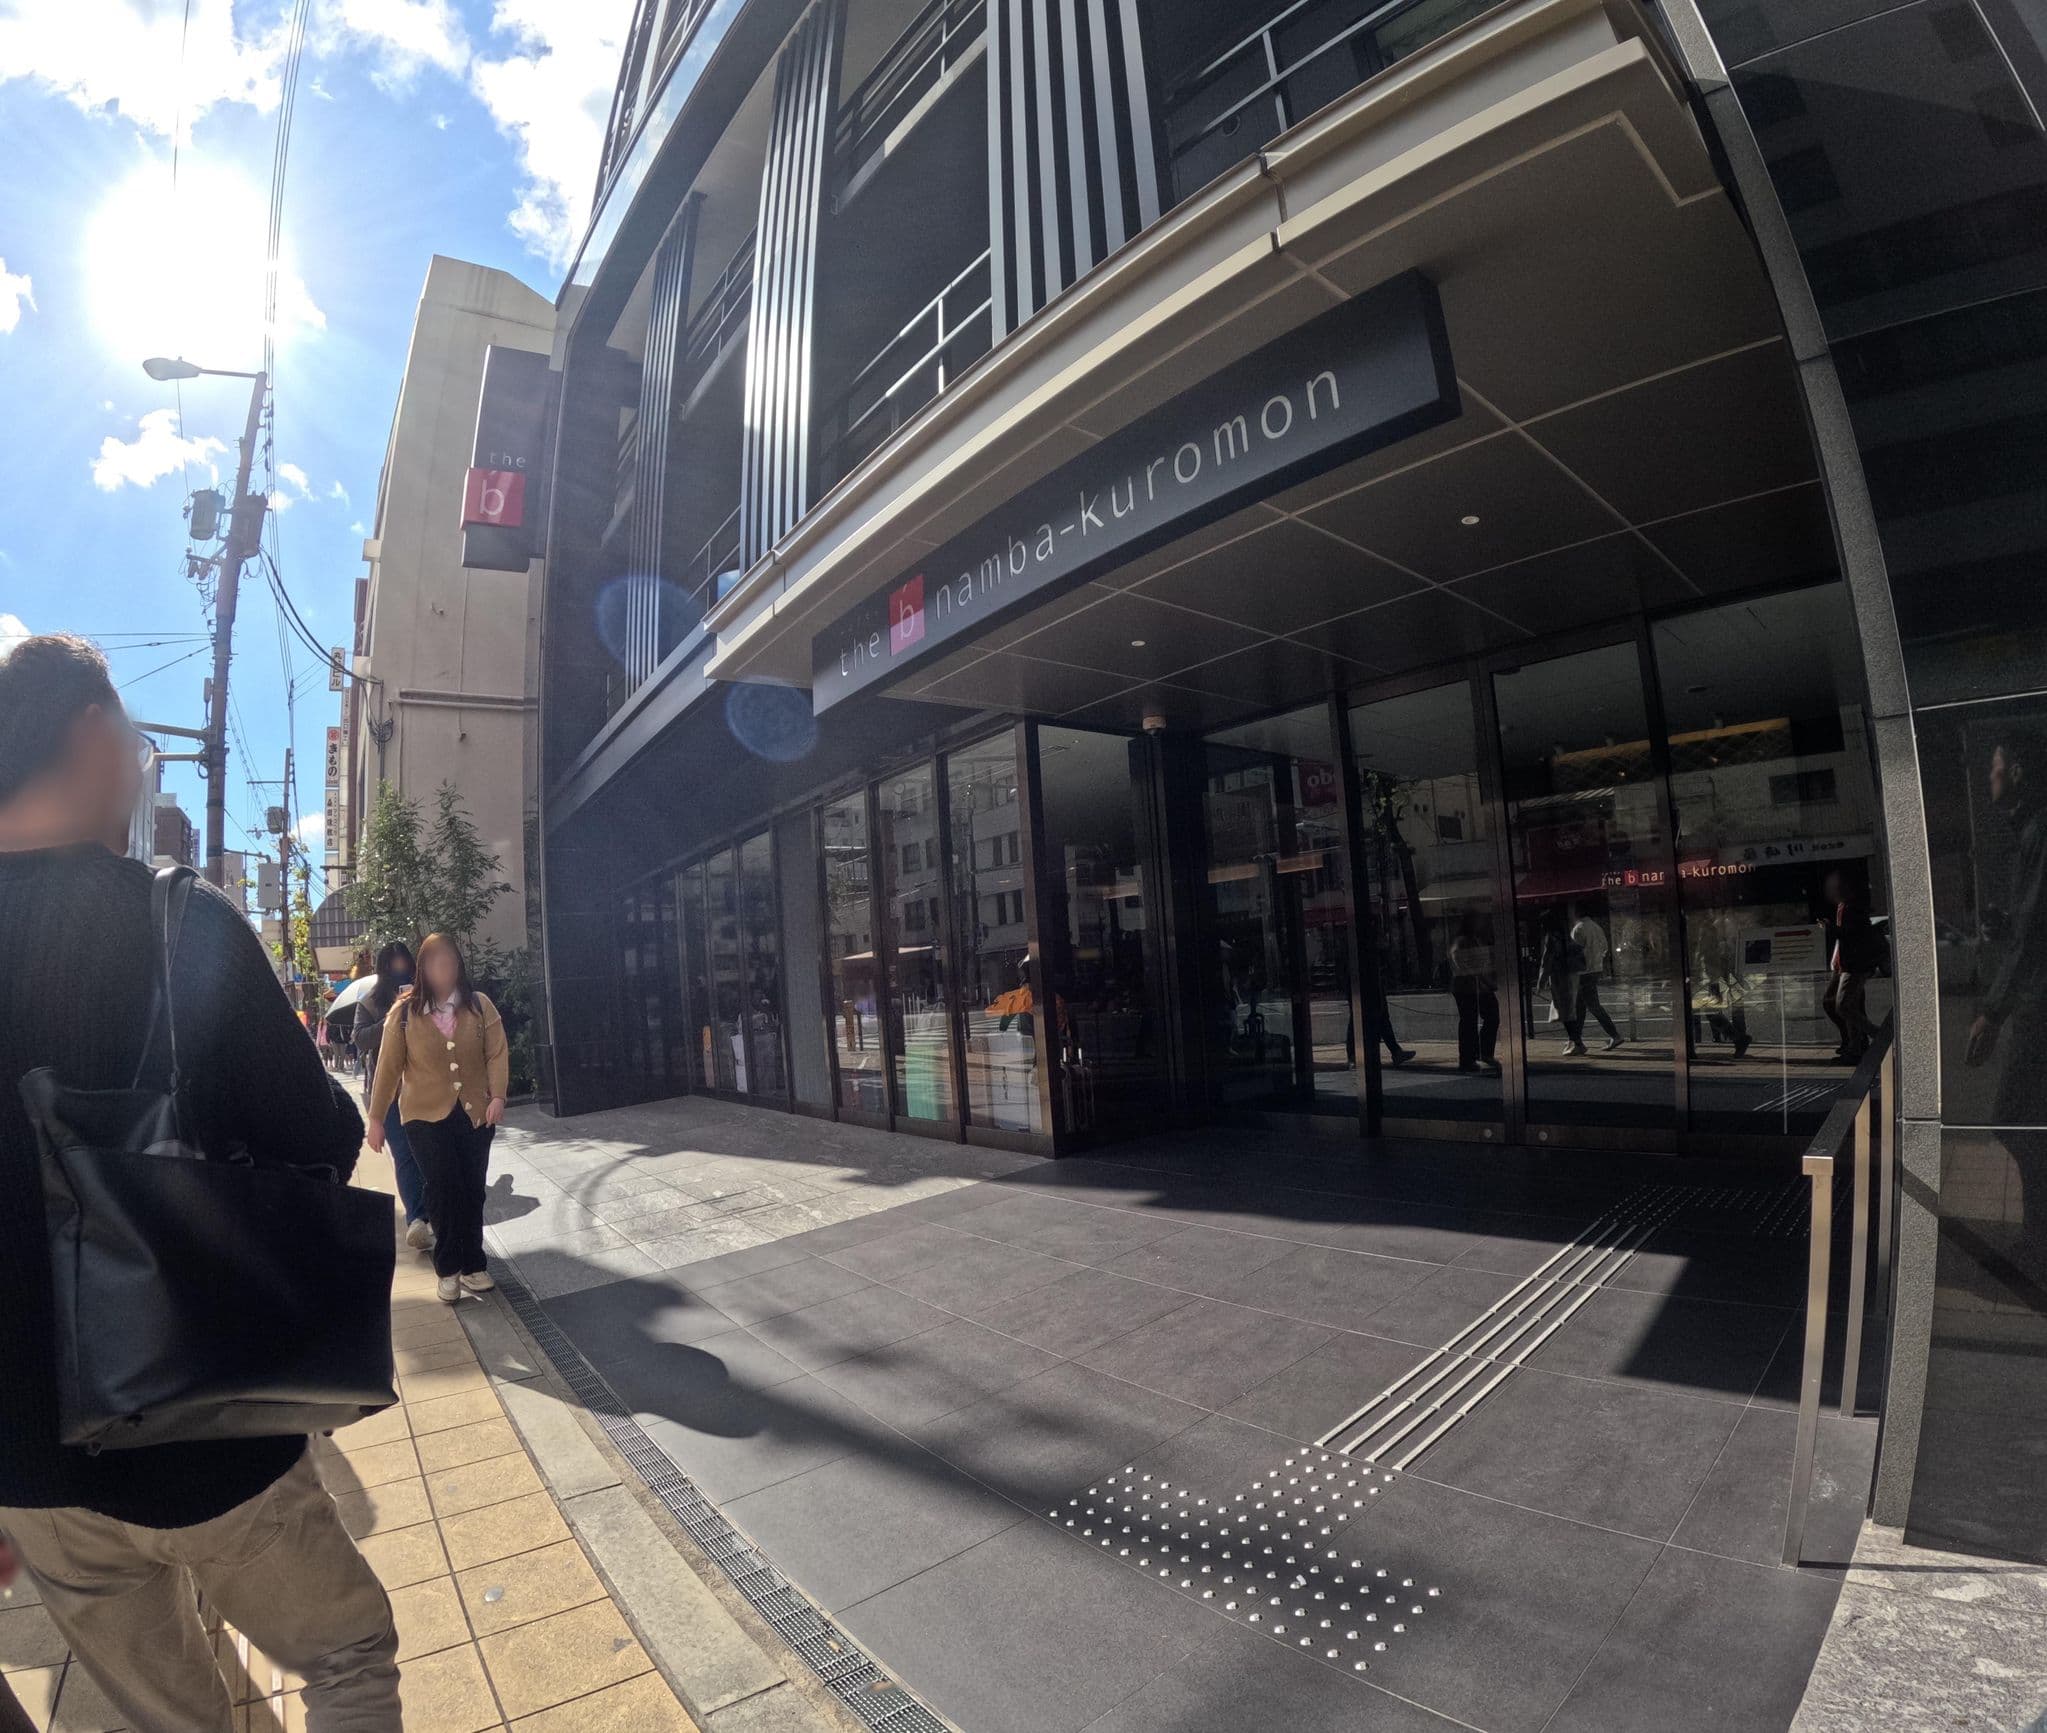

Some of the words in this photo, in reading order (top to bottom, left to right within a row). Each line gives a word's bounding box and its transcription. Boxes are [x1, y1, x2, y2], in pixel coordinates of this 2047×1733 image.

[488, 452, 526, 468] the
[841, 632, 880, 677] the
[936, 370, 1341, 622] namba-kuromon
